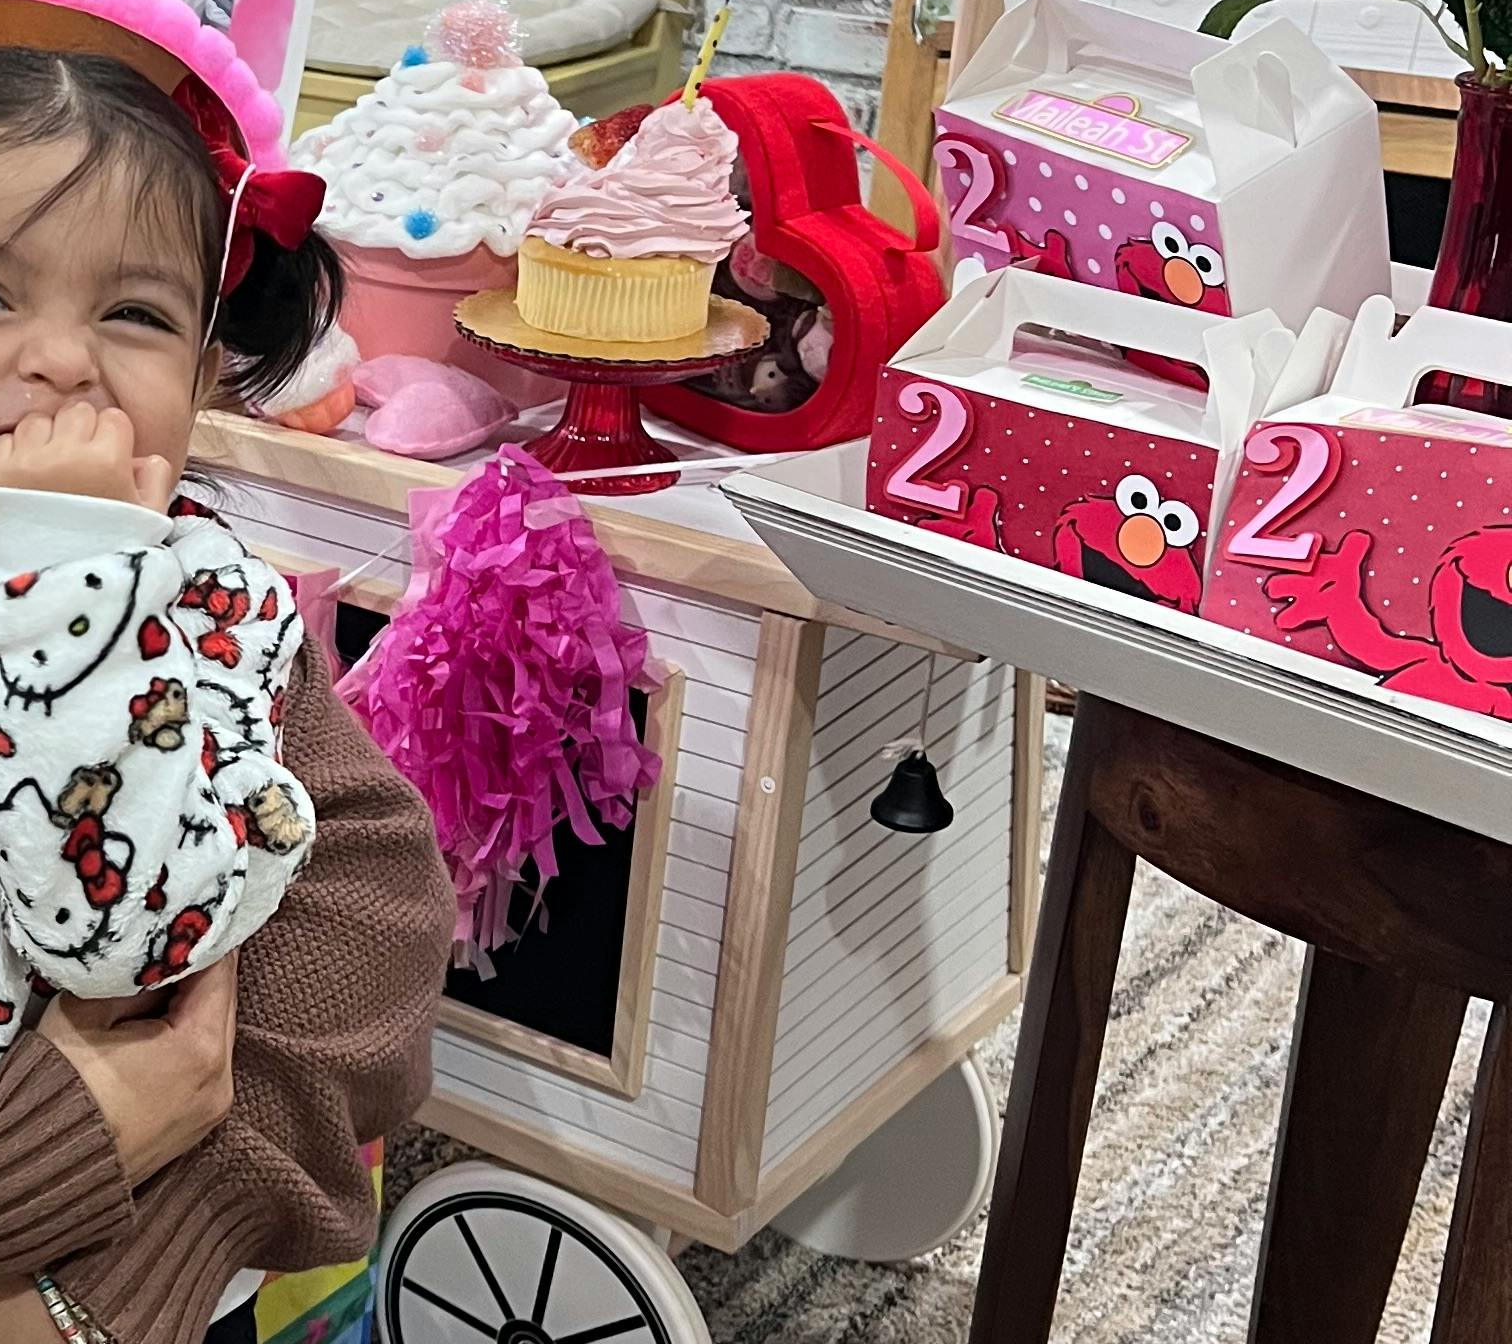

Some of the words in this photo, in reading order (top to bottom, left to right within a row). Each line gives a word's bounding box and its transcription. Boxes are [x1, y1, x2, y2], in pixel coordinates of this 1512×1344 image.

[938, 139, 1012, 254] 2
[886, 383, 965, 513] 2
[1226, 425, 1333, 561] 2
